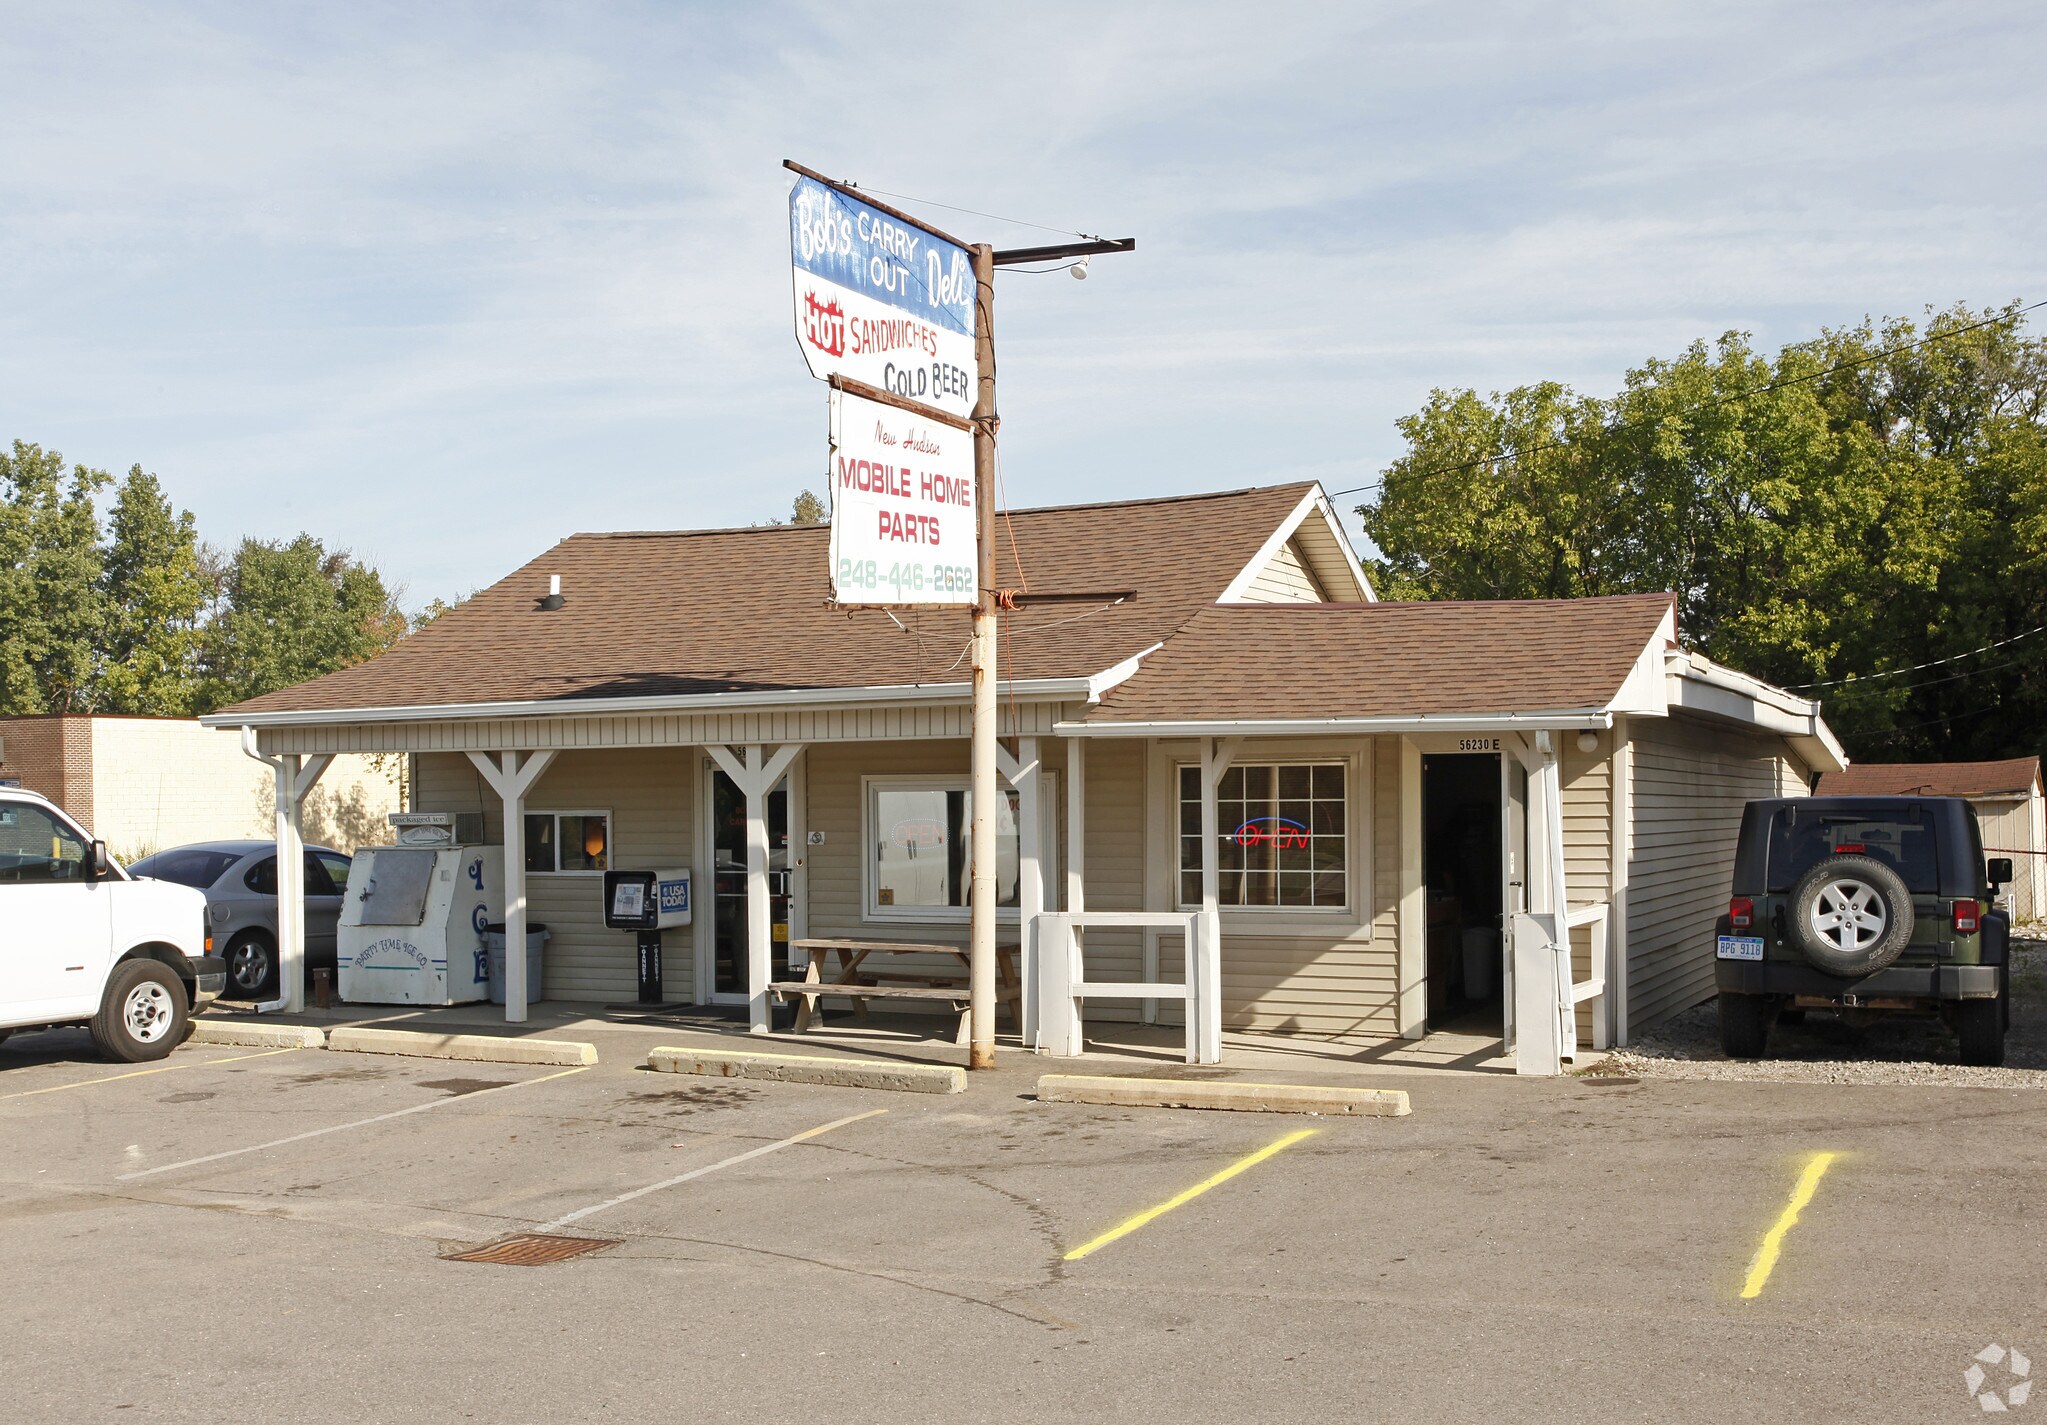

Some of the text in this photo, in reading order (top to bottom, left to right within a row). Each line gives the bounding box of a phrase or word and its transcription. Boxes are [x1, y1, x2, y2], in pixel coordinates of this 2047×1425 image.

[796, 191, 852, 262] Bob's
[857, 211, 919, 262] CARRY
[870, 256, 910, 296] OUT
[926, 249, 967, 308] Deli
[804, 301, 938, 357] HOT SANDWICHES
[884, 362, 969, 402] COLD BEER
[874, 419, 941, 456] New Hudson
[838, 455, 970, 507] MOBILE HOME
[878, 510, 940, 546] PARTS
[838, 558, 973, 593] 248-446-2662
[737, 746, 747, 756] 56
[1459, 738, 1500, 751] 56230 E
[391, 815, 431, 825] packaged
[894, 822, 945, 847] OPEN
[1237, 824, 1311, 849] OPEN
[661, 894, 687, 907] TODAY
[669, 885, 686, 897] USA
[354, 942, 378, 968] PARTY
[1720, 942, 1736, 954] BPG
[1740, 943, 1761, 956] 9118
